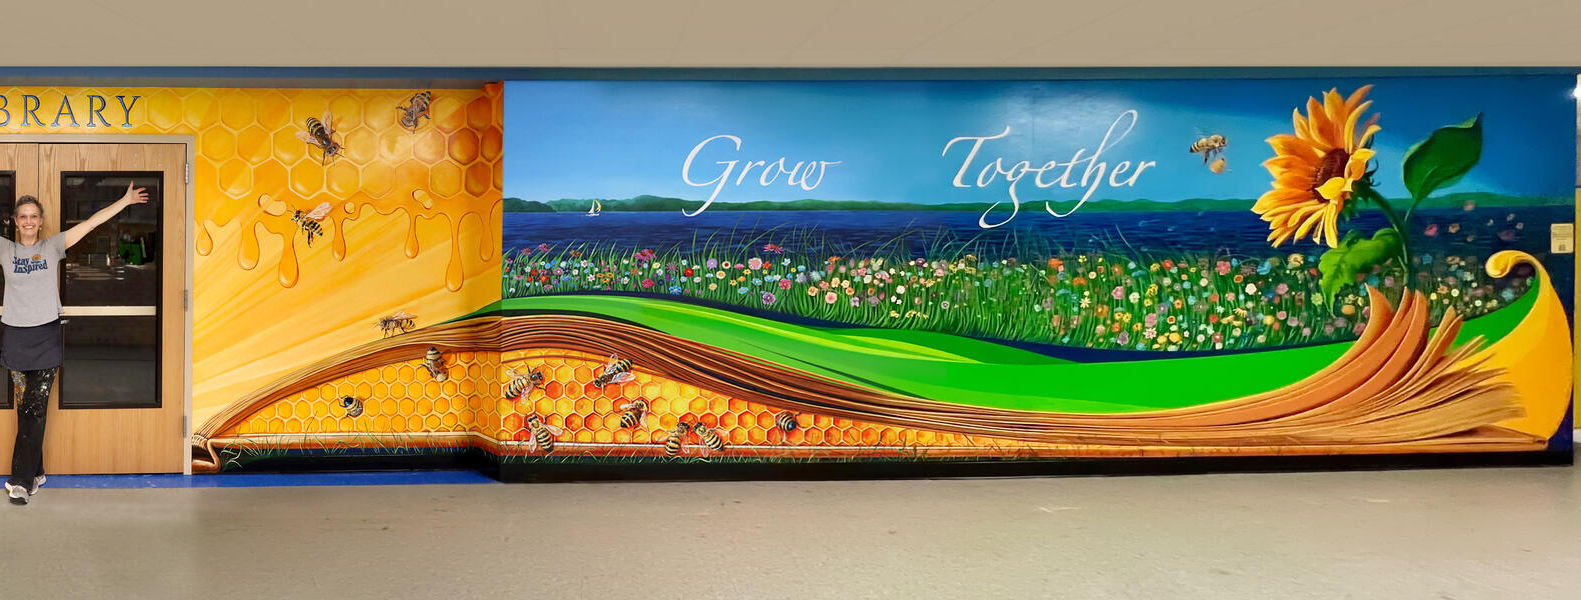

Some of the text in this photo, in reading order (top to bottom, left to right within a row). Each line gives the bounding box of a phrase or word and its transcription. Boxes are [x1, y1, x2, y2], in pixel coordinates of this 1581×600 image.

[681, 134, 843, 217] Grow
[941, 109, 1157, 229] Together
[12, 256, 30, 266] Stay
[13, 259, 48, 274] Inspired
